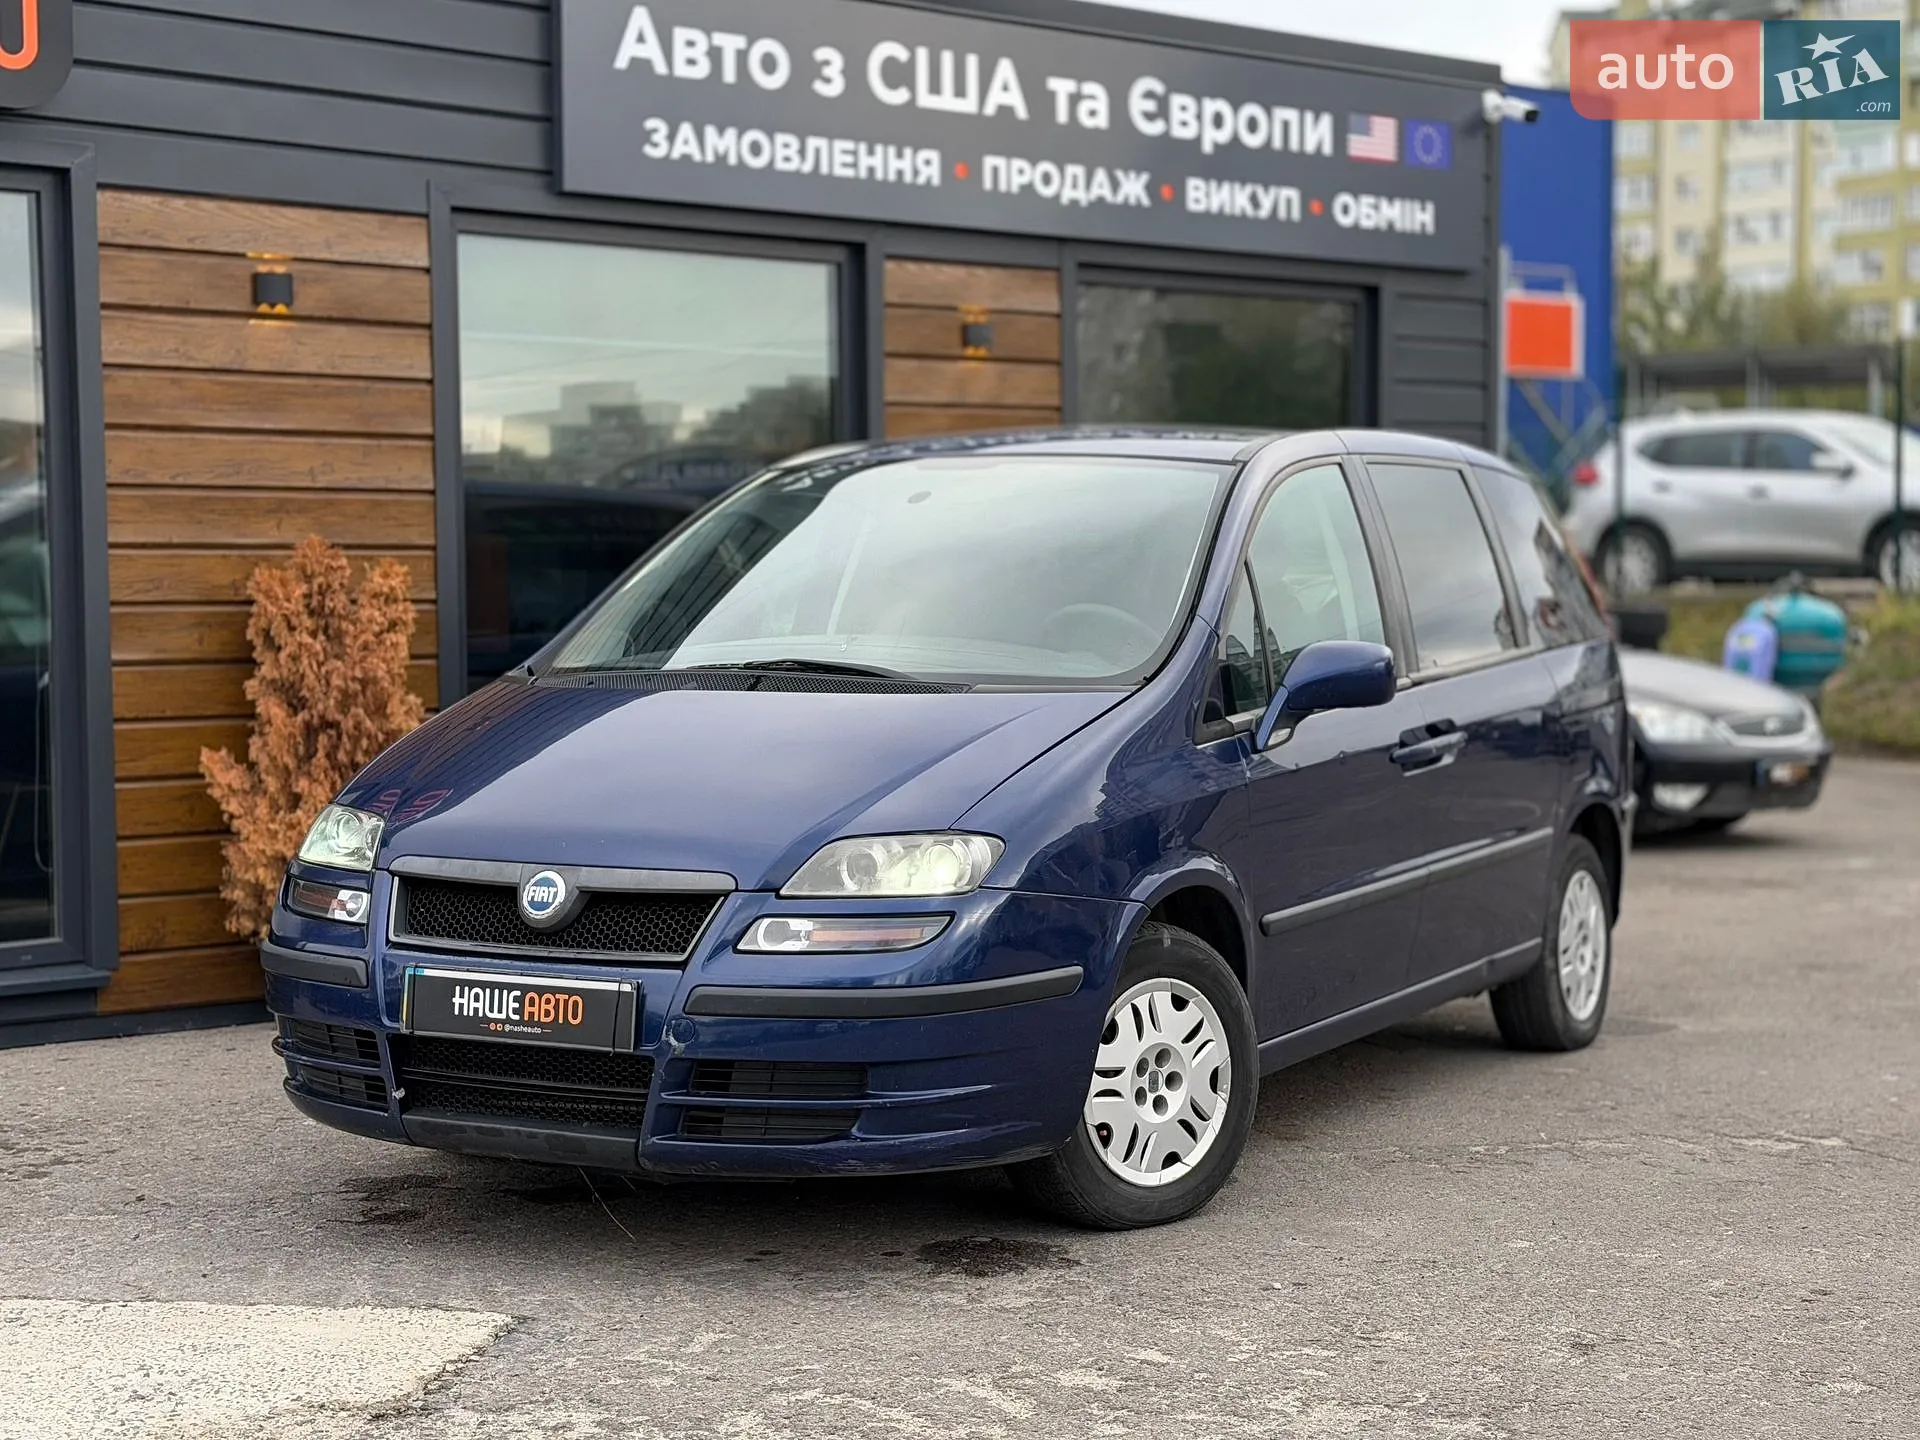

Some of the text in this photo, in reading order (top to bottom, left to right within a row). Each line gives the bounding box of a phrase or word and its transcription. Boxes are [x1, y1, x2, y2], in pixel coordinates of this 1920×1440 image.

[613, 5, 1333, 156] Авто з США та Європи
[642, 117, 1435, 235] ЗАМОВЛЕННЯ ПРОДАЖ ВИКУП ОБМІН
[527, 885, 557, 902] FIAT
[452, 985, 583, 1025] НАШЕ АВТО
